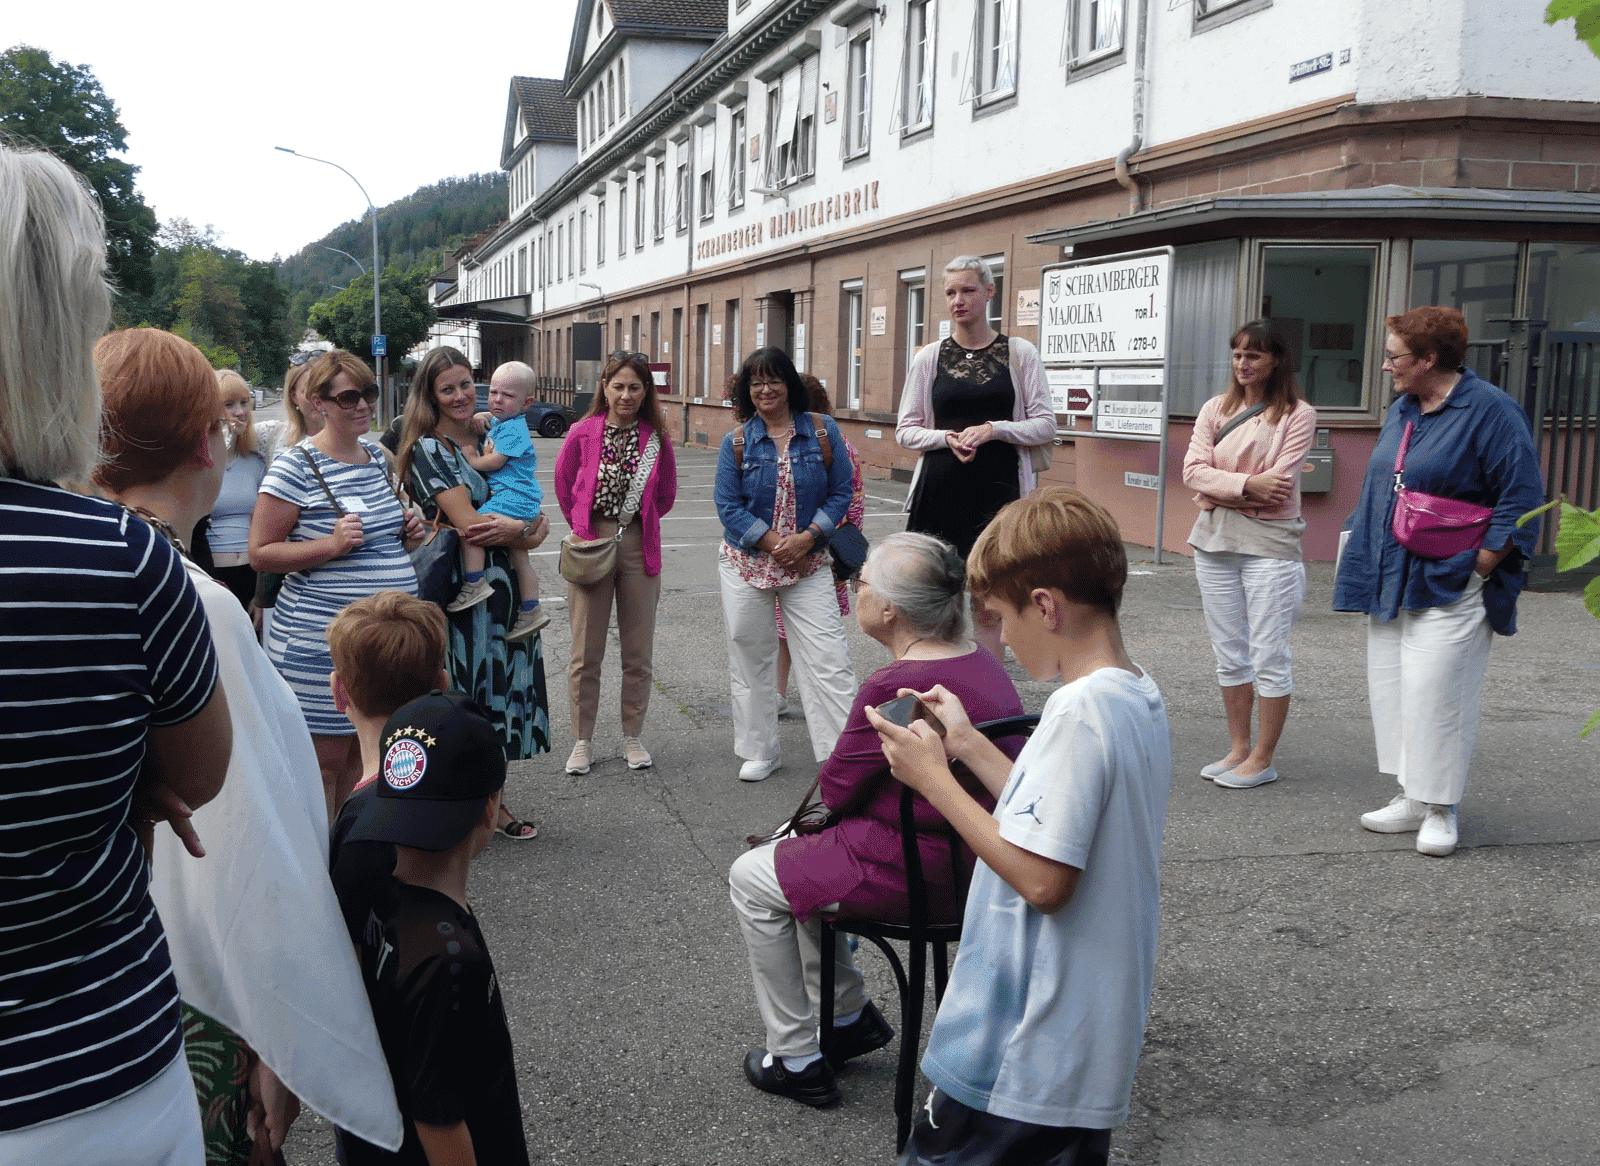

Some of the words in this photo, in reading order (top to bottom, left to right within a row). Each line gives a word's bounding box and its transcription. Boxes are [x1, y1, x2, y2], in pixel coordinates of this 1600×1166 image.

[697, 221, 763, 261] SCHRAMBERGER
[769, 180, 879, 239] MAJOLIKAFABRIK
[1065, 264, 1159, 296] SCHRAMBERGER
[1048, 303, 1102, 326] MAJOLIKA
[1135, 308, 1148, 319] TOR
[1047, 331, 1116, 354] FIRMENPARK
[1118, 419, 1152, 432] Lieferanten
[395, 742, 423, 762] BAYERN
